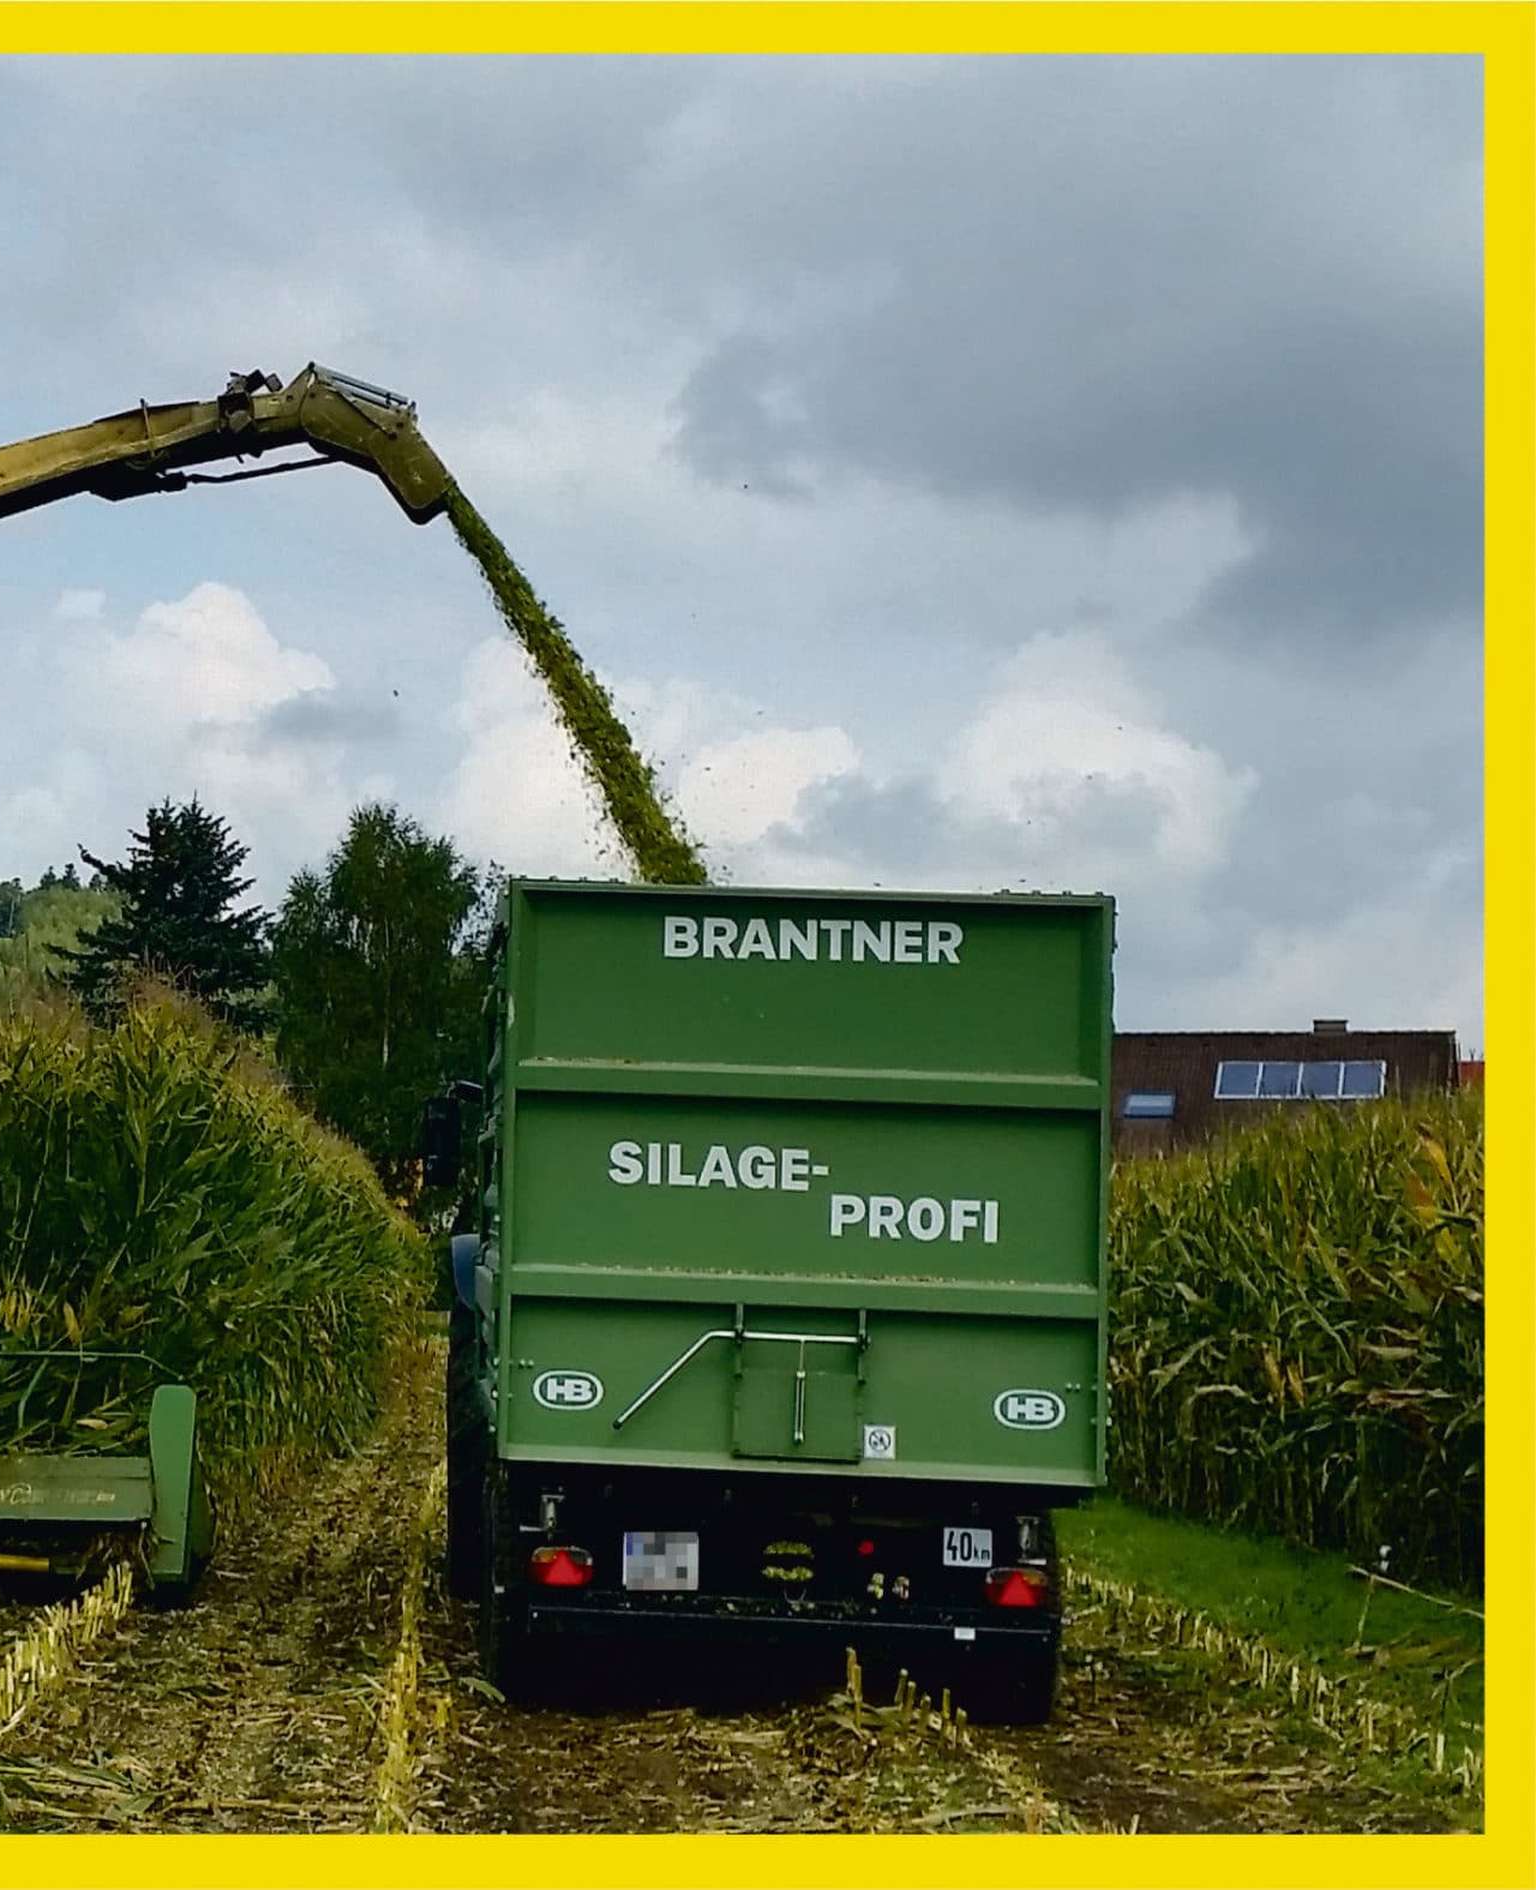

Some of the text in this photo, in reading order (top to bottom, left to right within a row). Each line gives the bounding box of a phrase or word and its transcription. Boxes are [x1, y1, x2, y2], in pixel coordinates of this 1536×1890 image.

[663, 916, 963, 964] BRANTNER
[608, 1140, 830, 1192] SILAGE-
[829, 1194, 1000, 1244] PROFI
[546, 1378, 593, 1402] HB
[1007, 1396, 1055, 1422] HB
